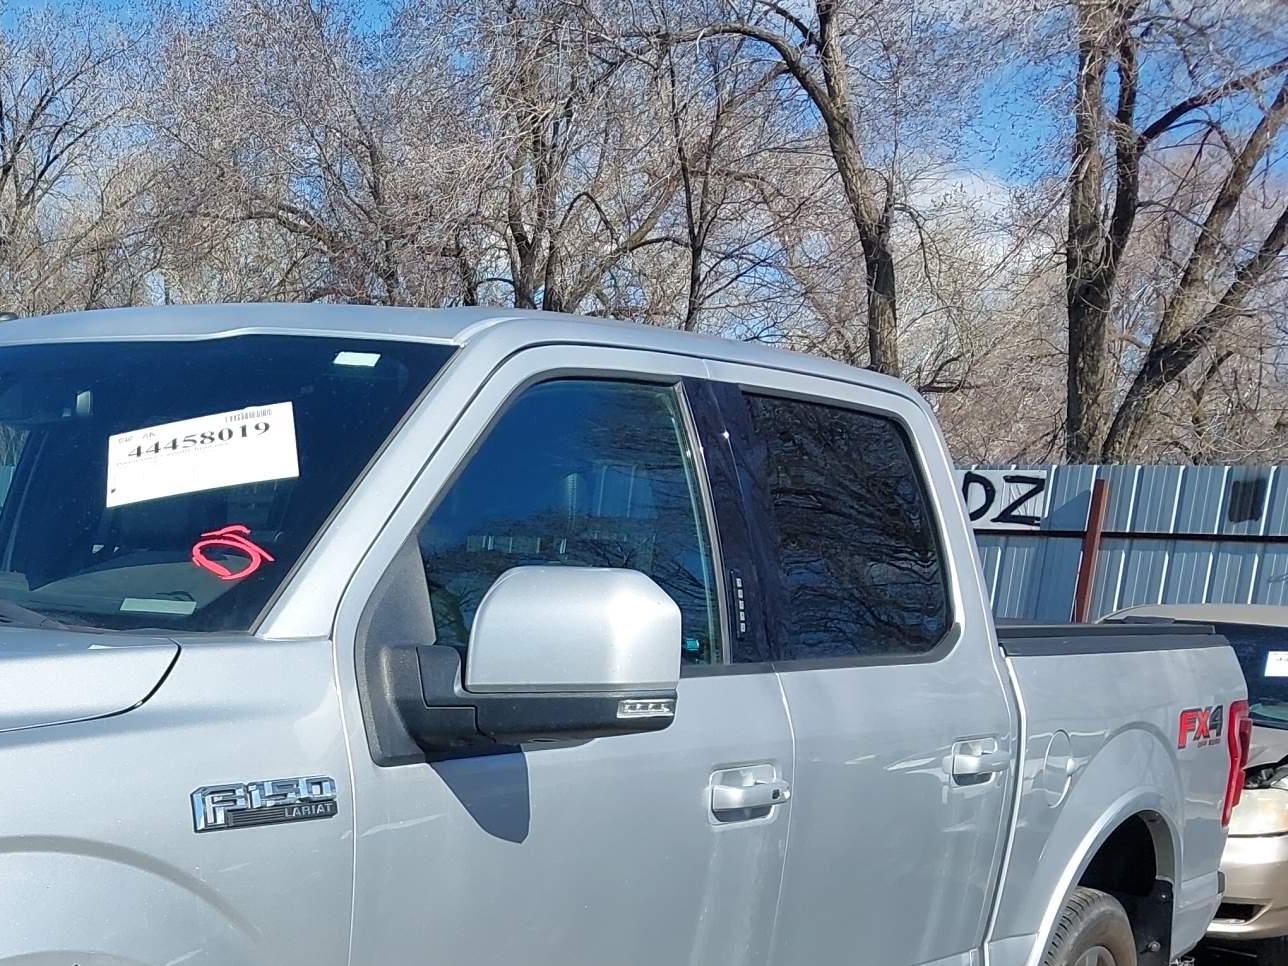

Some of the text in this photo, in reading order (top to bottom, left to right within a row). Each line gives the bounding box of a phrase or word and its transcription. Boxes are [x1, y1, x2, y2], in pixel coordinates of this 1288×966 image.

[127, 420, 271, 458] 44458019
[1178, 704, 1223, 749] FX4
[284, 802, 334, 818] LARIAT
